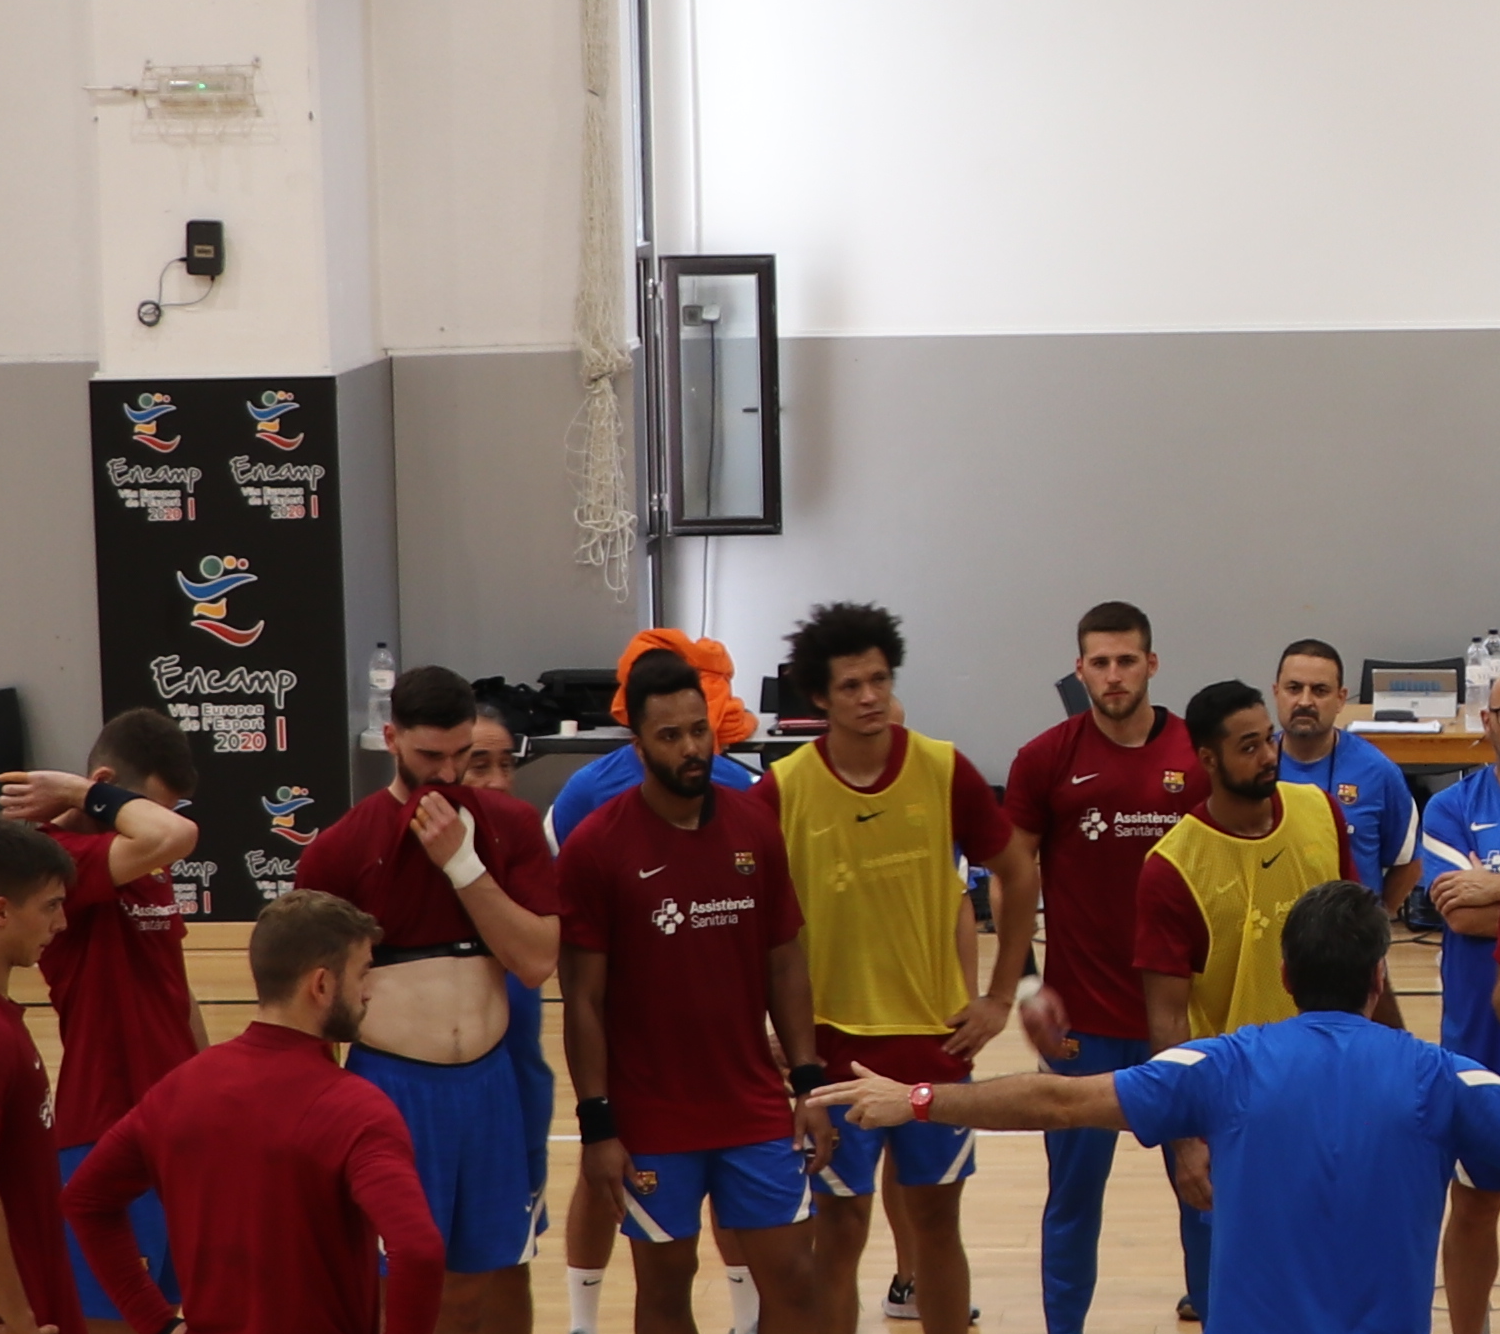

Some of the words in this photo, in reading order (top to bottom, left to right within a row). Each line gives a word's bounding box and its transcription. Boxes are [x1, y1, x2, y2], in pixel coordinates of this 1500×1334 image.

[107, 457, 202, 493] Encamp
[229, 455, 325, 491] Encamp
[148, 507, 183, 521] 2020
[270, 505, 306, 519] 2020
[150, 654, 298, 709] Encamp
[167, 703, 199, 717] Vila
[201, 702, 265, 718] Europea
[179, 718, 200, 732] de
[213, 731, 267, 752] 2020
